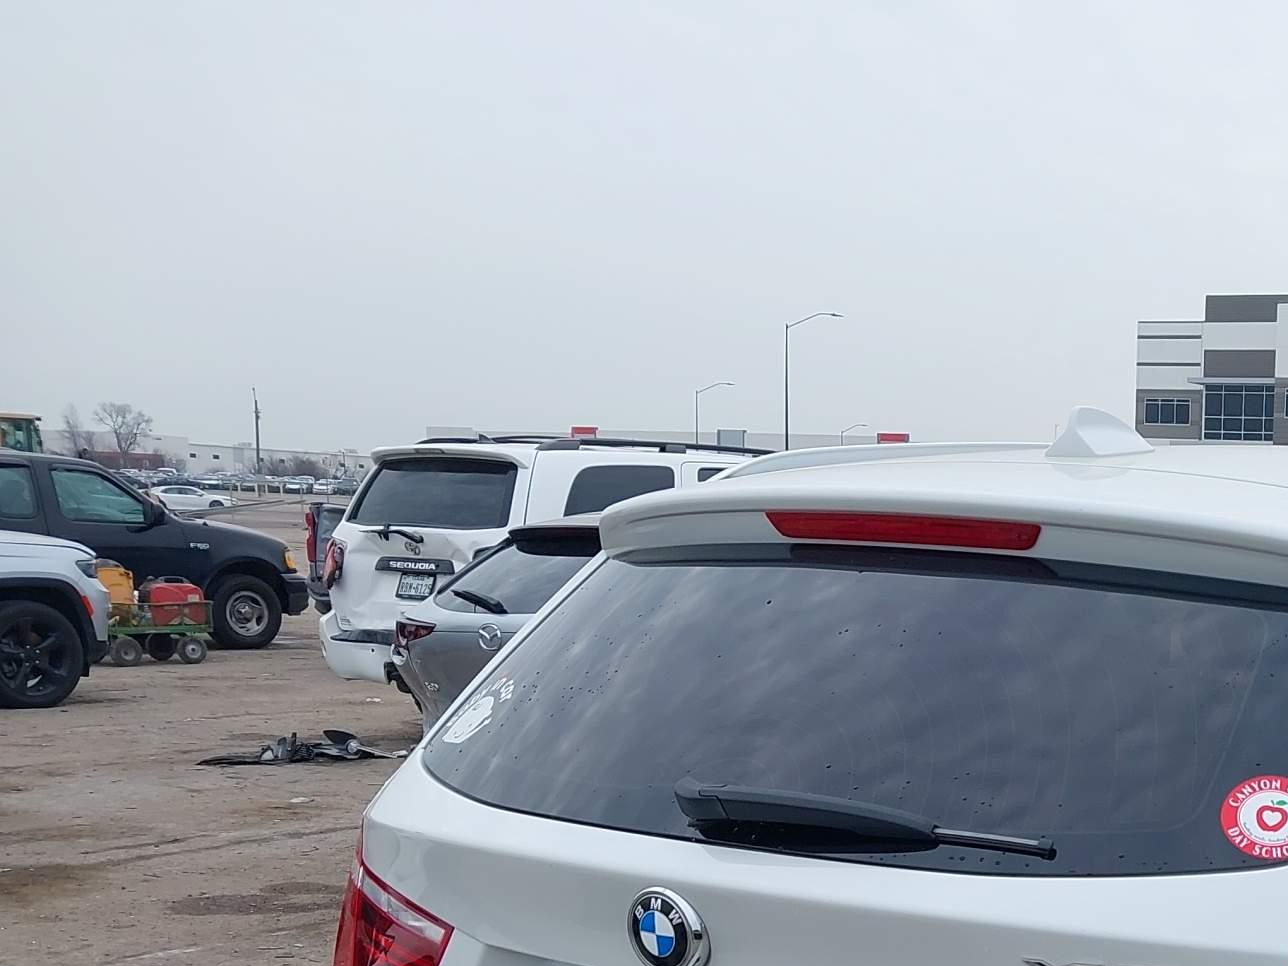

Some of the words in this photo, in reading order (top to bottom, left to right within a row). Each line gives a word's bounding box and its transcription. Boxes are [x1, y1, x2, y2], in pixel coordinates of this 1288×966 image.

[389, 561, 436, 570] SEQUOIA
[1228, 779, 1282, 808] CANYON
[1227, 826, 1251, 849] DAY
[634, 897, 683, 926] BMW
